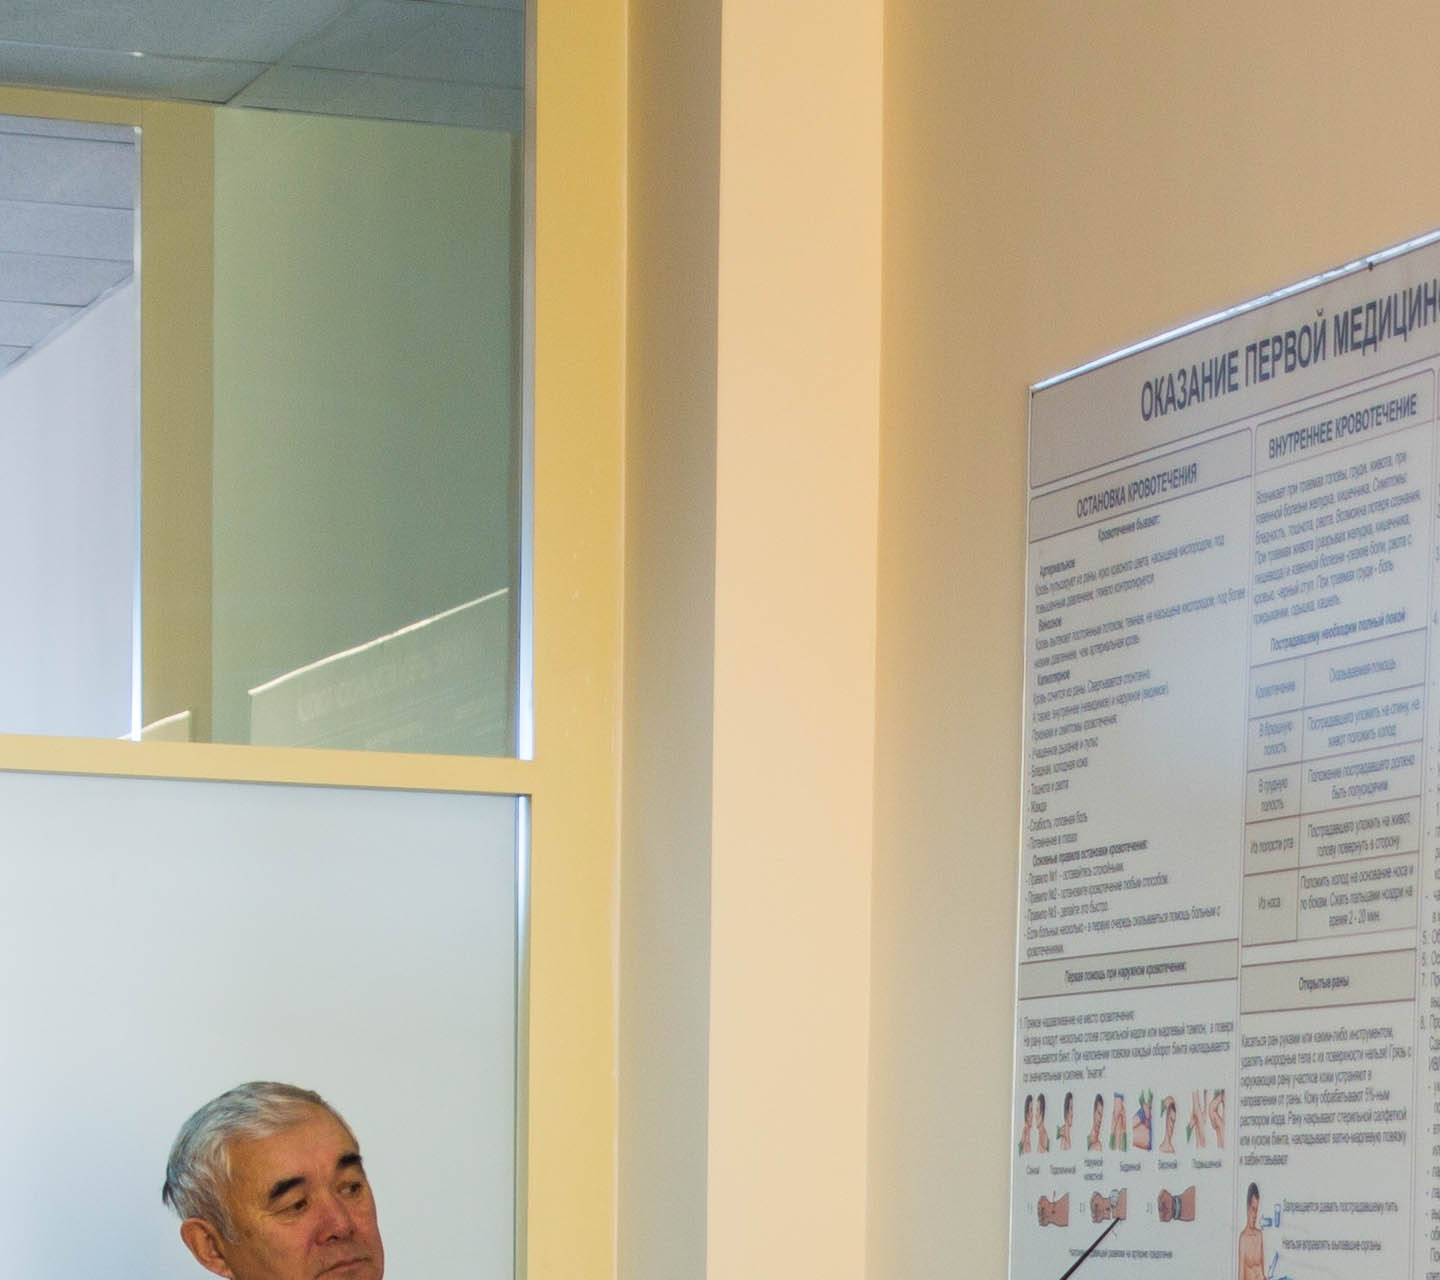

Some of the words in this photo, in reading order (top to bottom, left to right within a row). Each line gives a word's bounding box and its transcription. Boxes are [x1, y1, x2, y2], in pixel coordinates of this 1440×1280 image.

[1140, 348, 1239, 423] ОКАЗАНИЕ
[1244, 309, 1327, 389] ПЕРВОЙ
[1268, 419, 1333, 460] ВНУТРЕННЕЕ
[1335, 392, 1417, 439] КРОВОТЕЧЕНИЕ
[1076, 484, 1126, 519] ОСТАНОВКА
[1127, 462, 1197, 503] КРОВОТЕЧЕНИЯ
